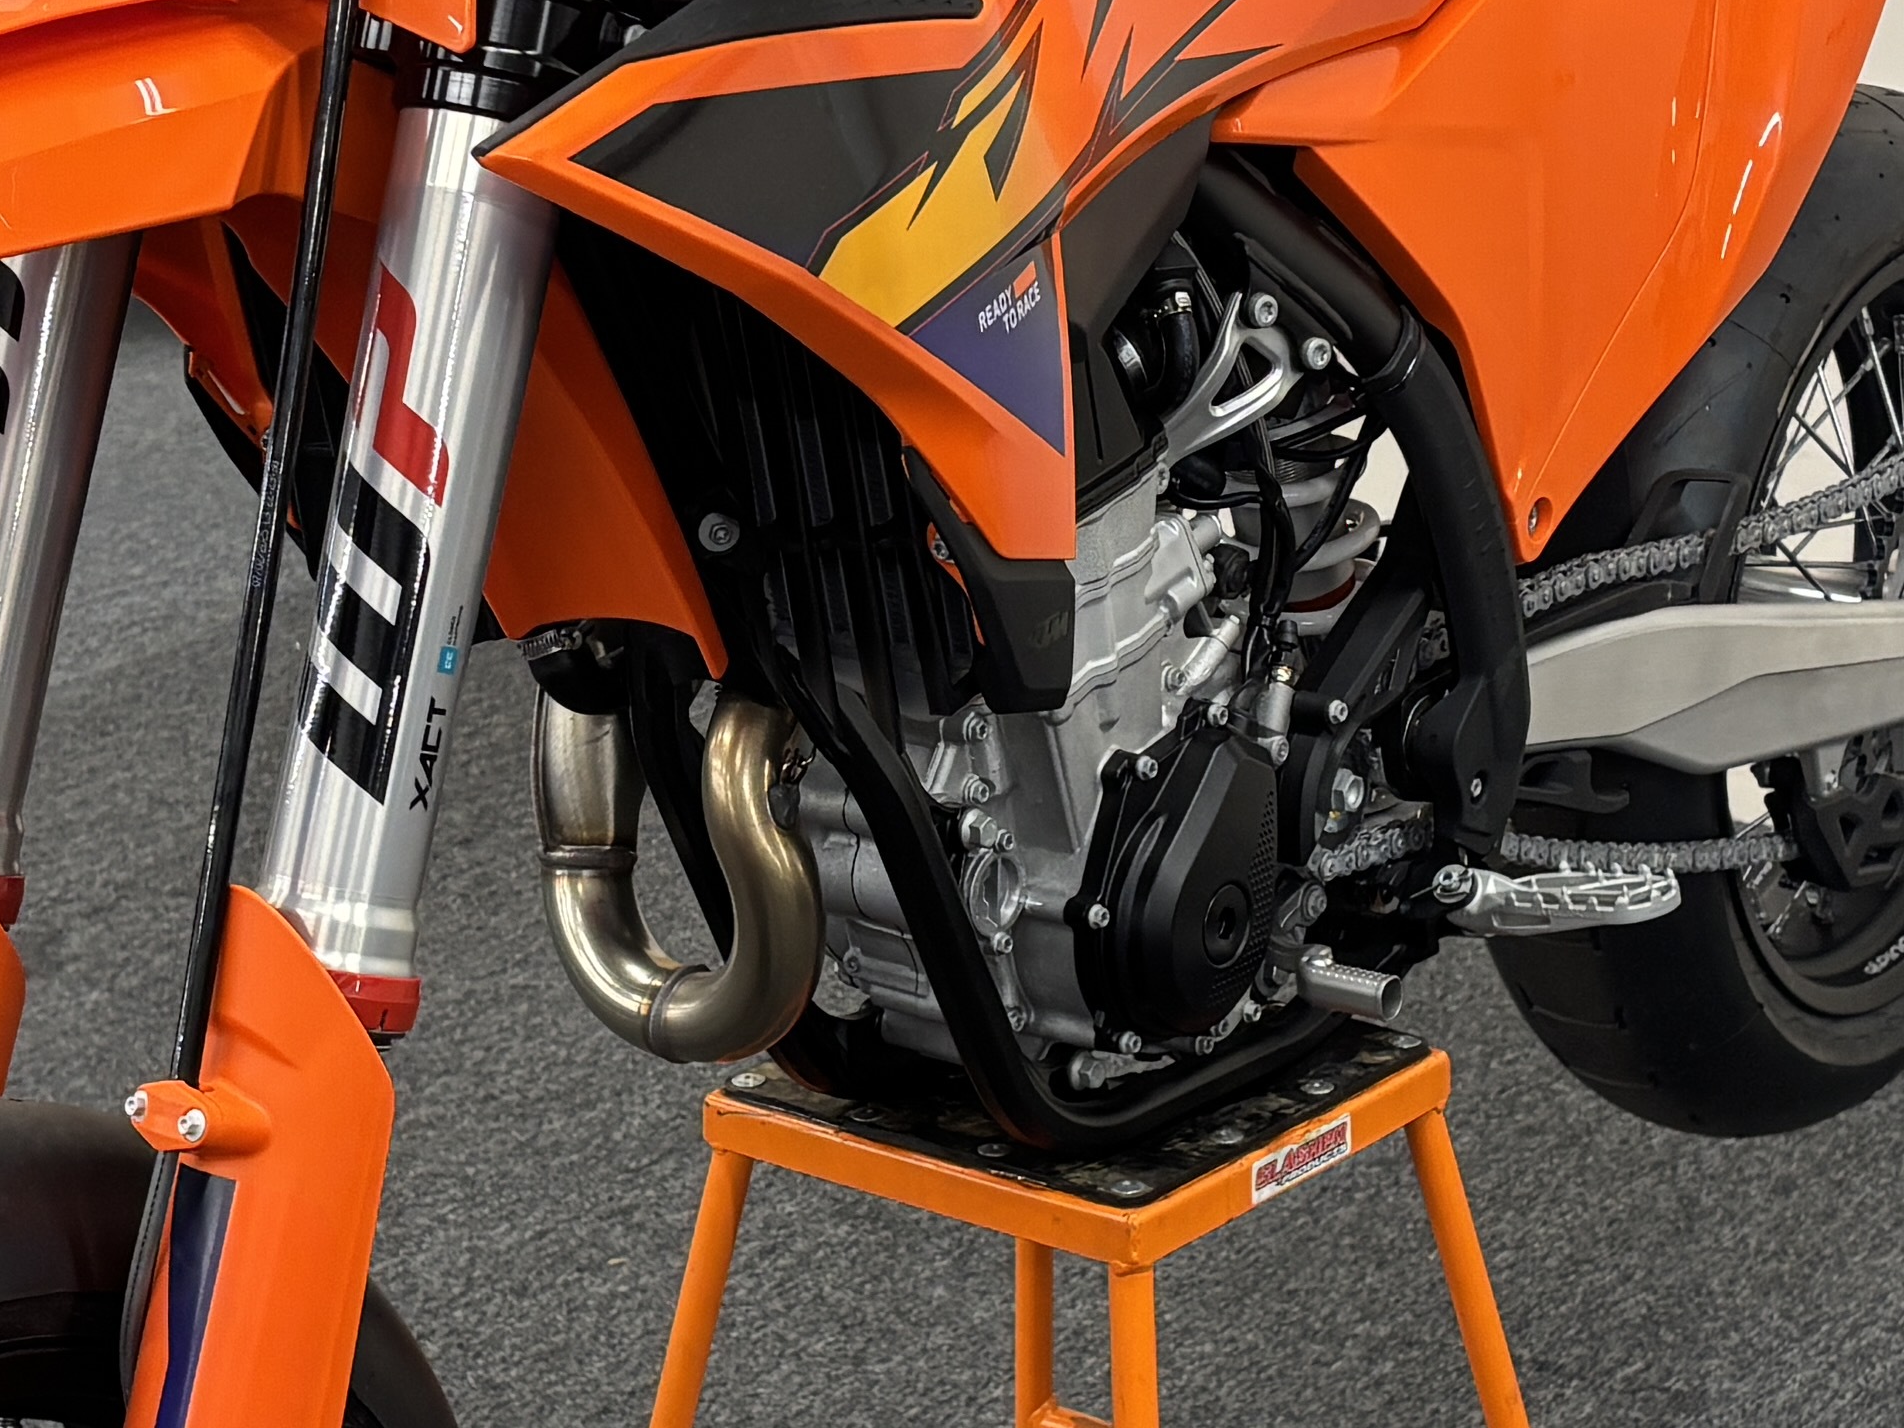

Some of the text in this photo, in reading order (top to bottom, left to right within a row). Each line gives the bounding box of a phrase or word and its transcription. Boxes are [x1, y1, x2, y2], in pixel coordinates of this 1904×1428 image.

[978, 284, 1013, 333] READY
[1002, 280, 1042, 334] TO RACE
[298, 257, 450, 806] WP
[408, 695, 449, 812] XACT
